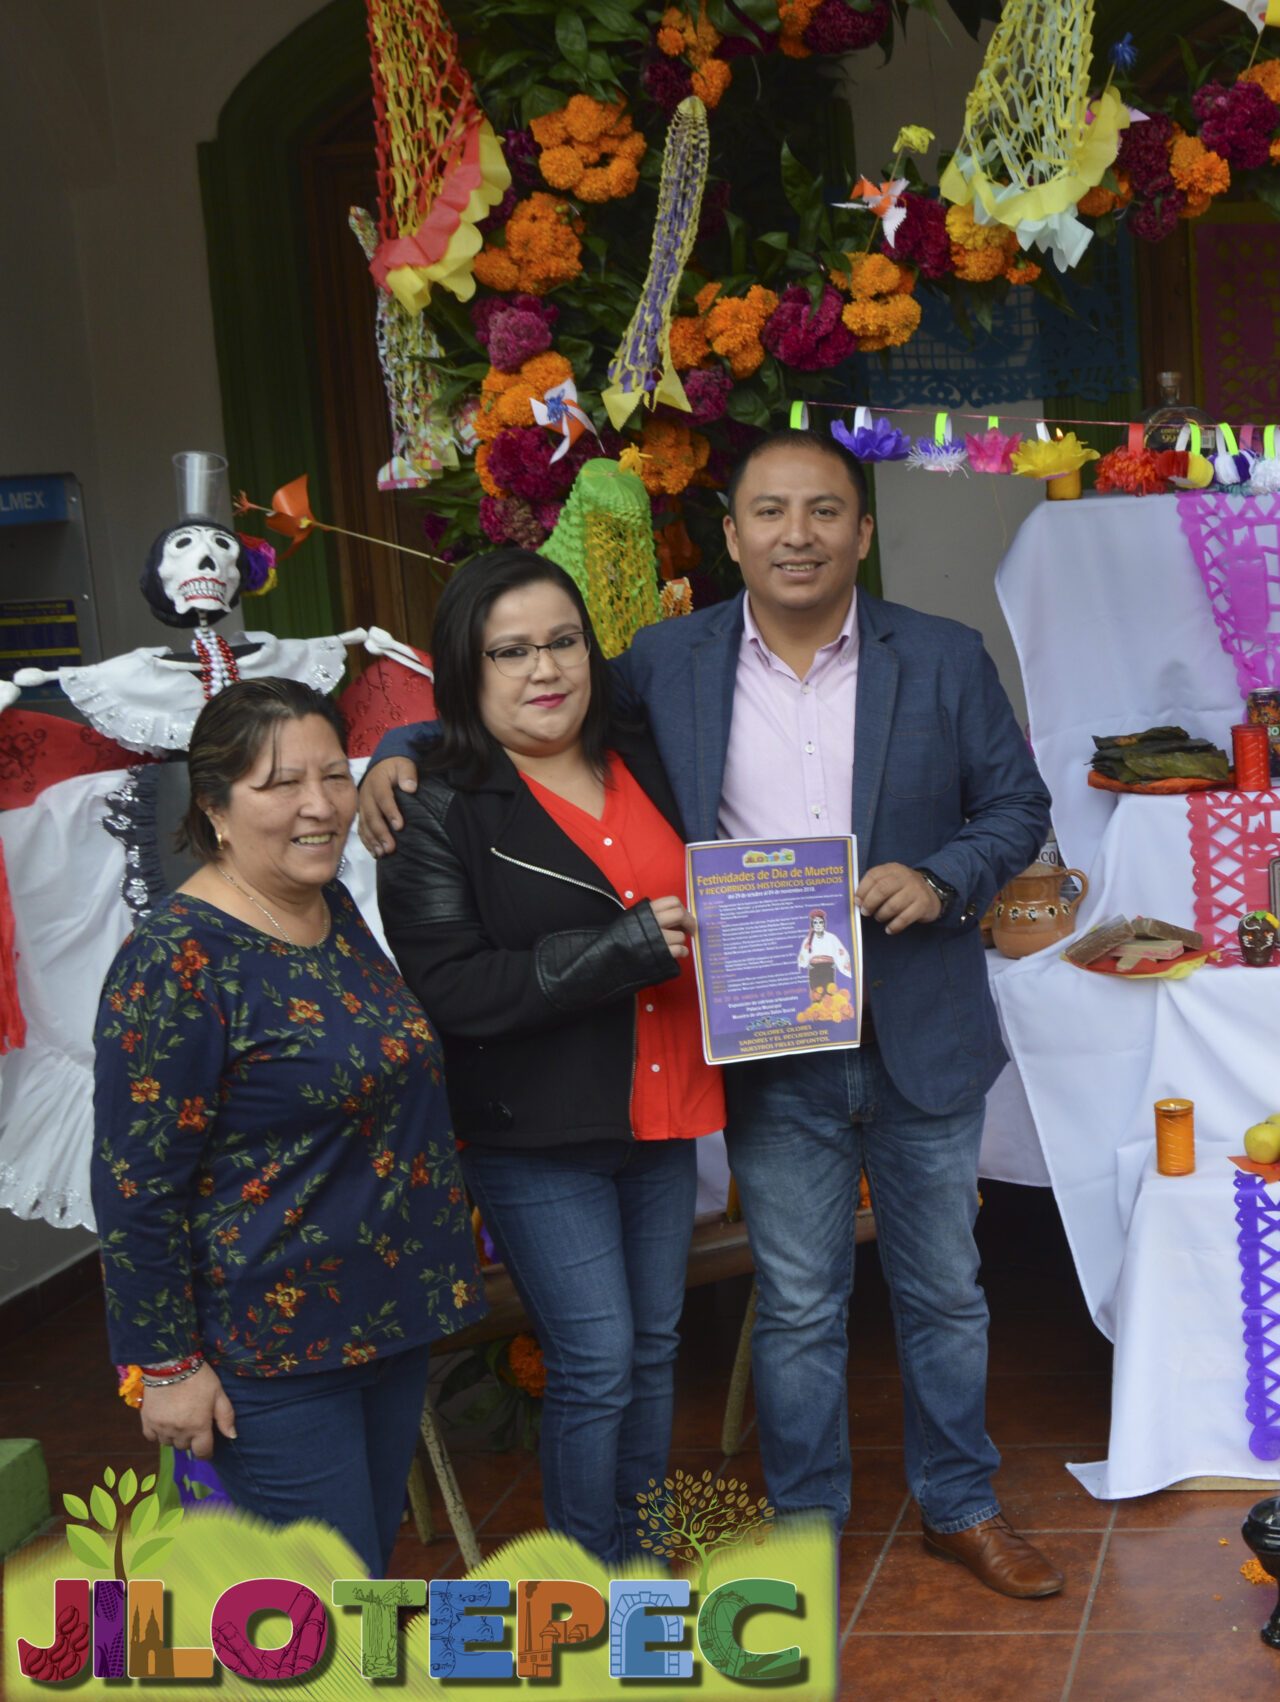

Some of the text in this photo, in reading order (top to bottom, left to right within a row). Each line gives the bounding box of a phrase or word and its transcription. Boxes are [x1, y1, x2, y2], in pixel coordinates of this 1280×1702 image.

[697, 869, 755, 886] Festividades
[757, 868, 769, 879] de
[791, 866, 802, 878] de
[805, 865, 844, 876] Muertos
